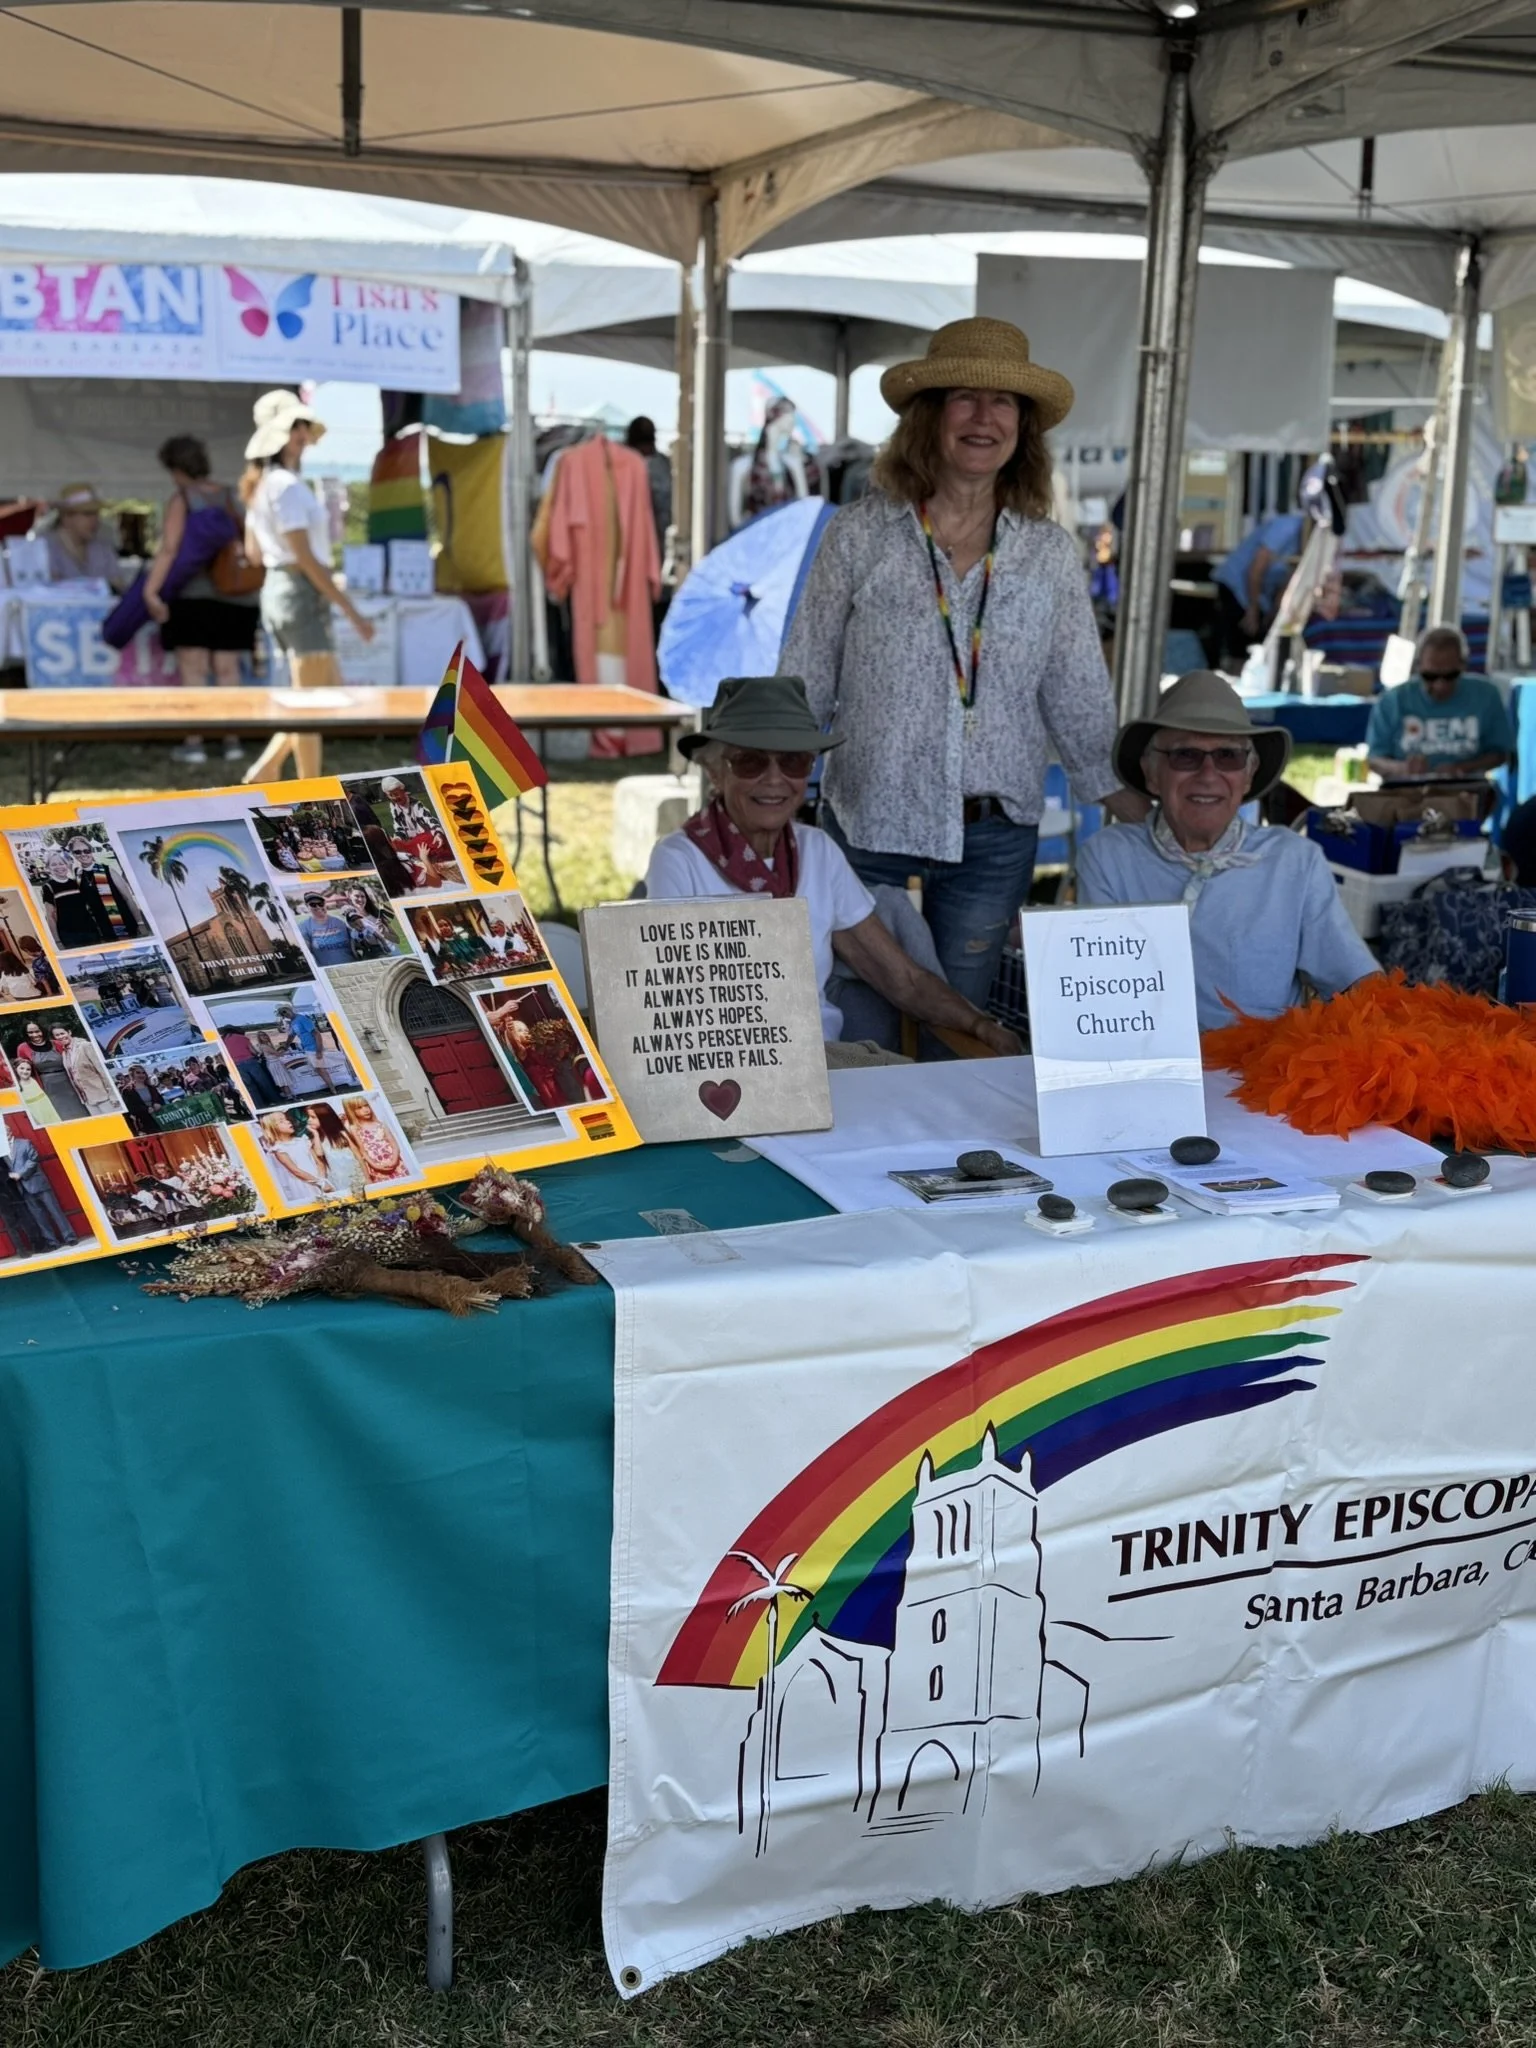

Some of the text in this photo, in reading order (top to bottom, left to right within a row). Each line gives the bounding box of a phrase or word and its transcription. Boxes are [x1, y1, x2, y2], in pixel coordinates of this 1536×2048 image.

[331, 275, 439, 311] Lisas
[333, 312, 443, 350] Place
[640, 919, 762, 943] LOVE IS PATIENT,
[656, 941, 751, 964] LOVE IS KIND.
[1070, 935, 1146, 960] Trinity
[201, 952, 286, 969] TRINITY EPISCOPAL
[229, 965, 267, 977] CHURCH
[626, 961, 785, 988] IT ALWAYS PROTECTS,
[1060, 970, 1165, 1002] Episcopal
[644, 984, 768, 1009] ALWAYS TRUSTS,
[653, 1005, 768, 1030] ALWAYS HOPES,
[1077, 1010, 1155, 1035] Church
[633, 1026, 793, 1054] ALWAYS PERSEVERES.
[646, 1048, 783, 1076] LOVE NEVER FAILS.
[157, 1106, 192, 1125] TRINITY
[1112, 1503, 1313, 1577] TRINITY
[1244, 1590, 1343, 1630] Santa
[1355, 1562, 1490, 1611] Barbara,
